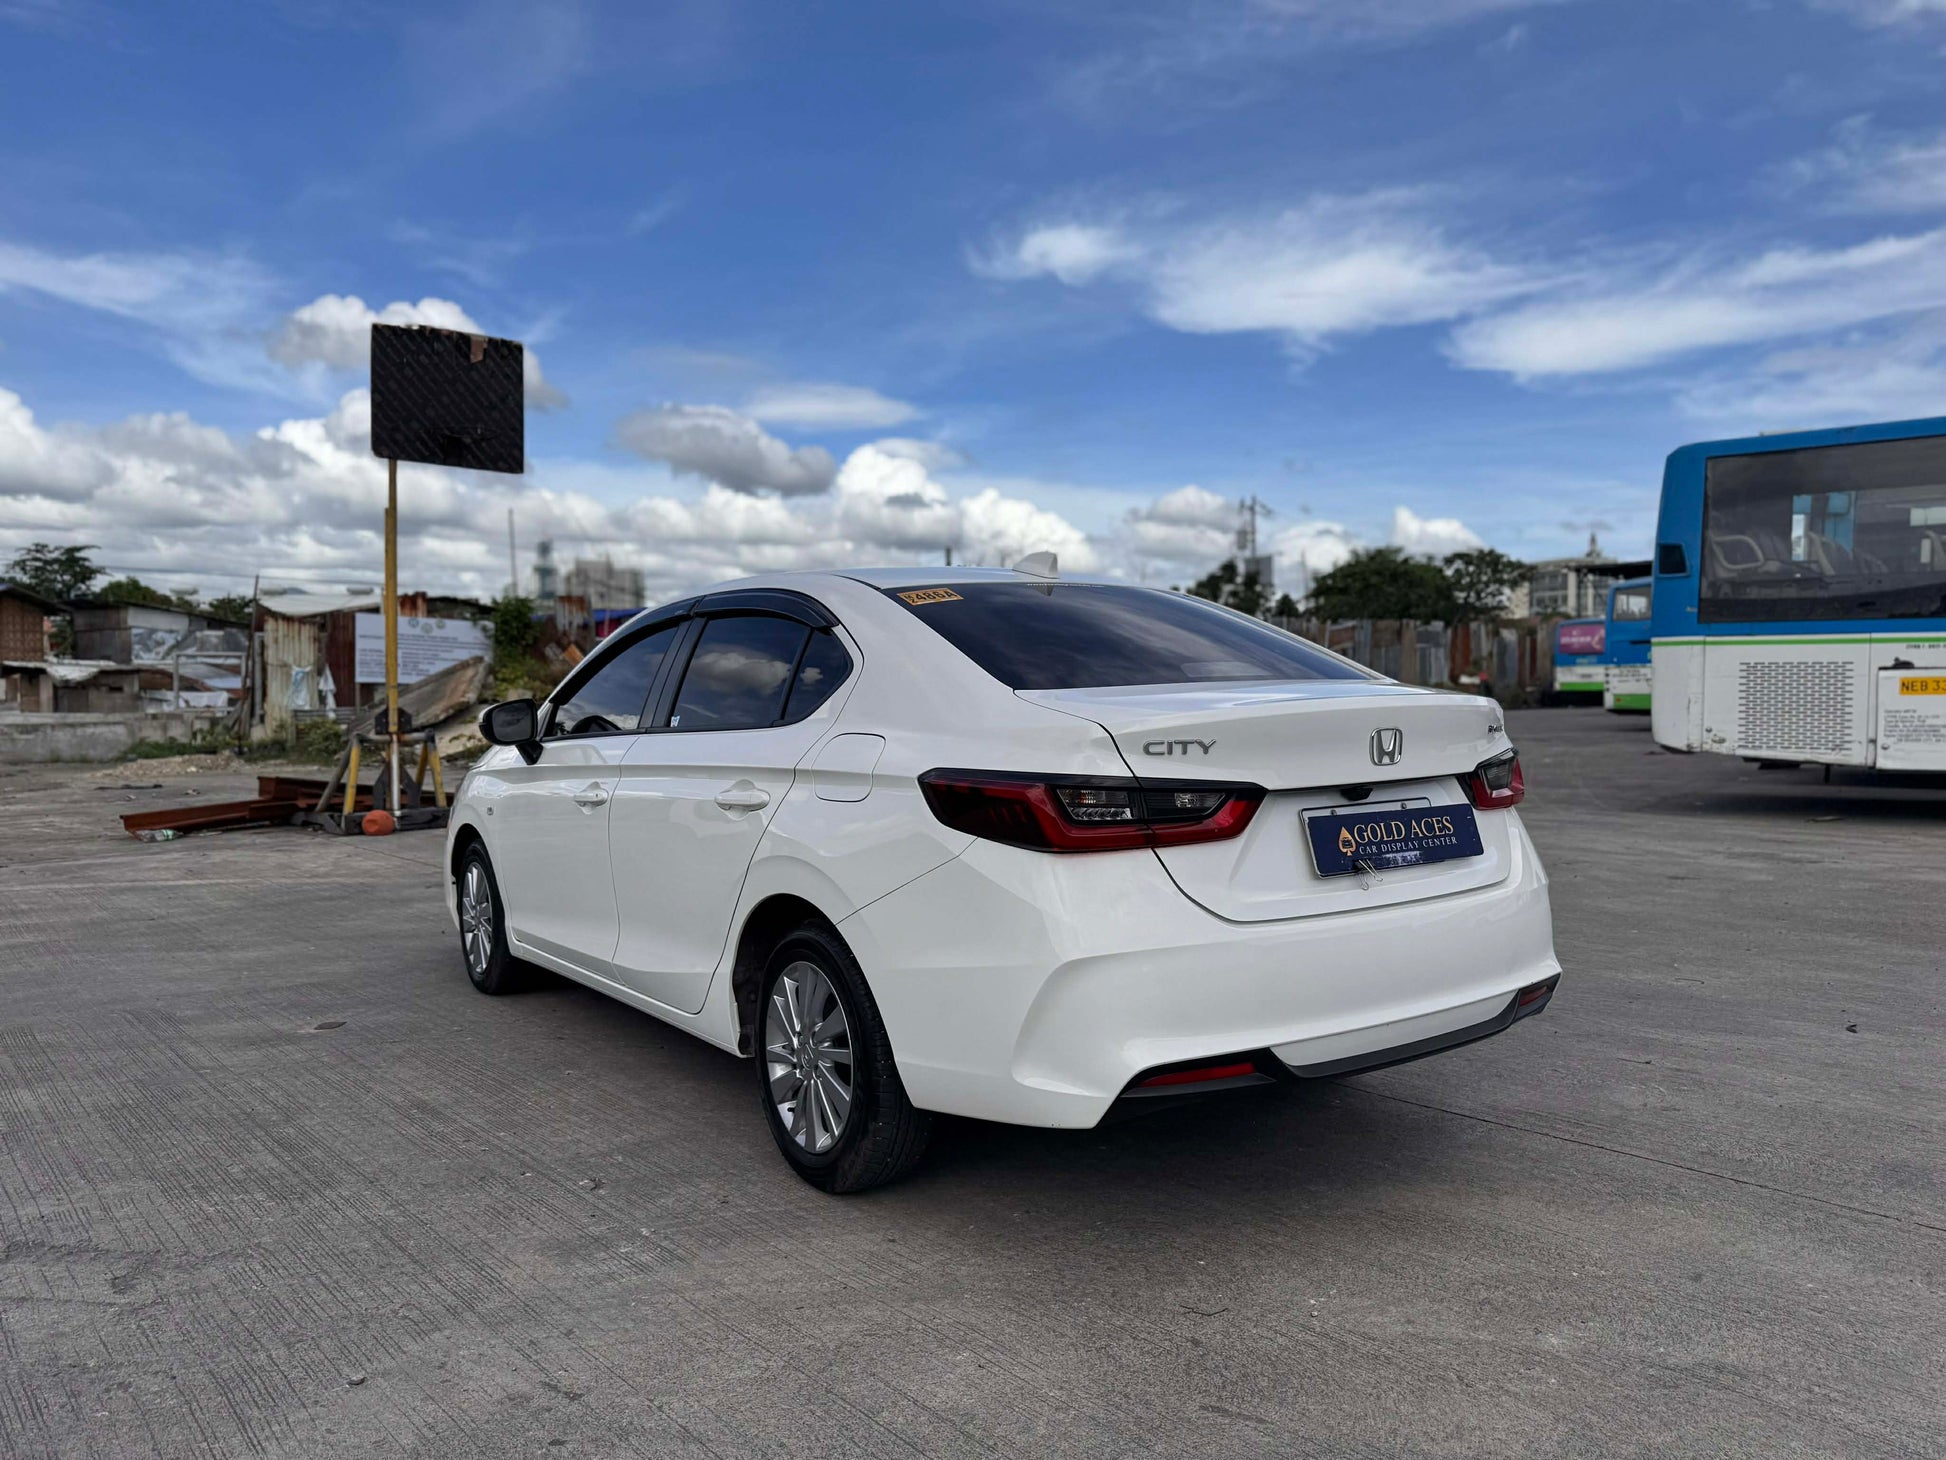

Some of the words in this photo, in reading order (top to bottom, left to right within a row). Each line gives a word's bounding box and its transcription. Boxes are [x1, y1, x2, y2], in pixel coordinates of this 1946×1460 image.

[1901, 680, 1928, 692] NEB
[1142, 739, 1216, 756] CITY
[1354, 821, 1405, 843] GOLD
[1411, 816, 1454, 838] ACES
[1360, 845, 1378, 855] CAR
[1381, 840, 1419, 852] DISPLAY
[1422, 836, 1458, 848] CENTER
